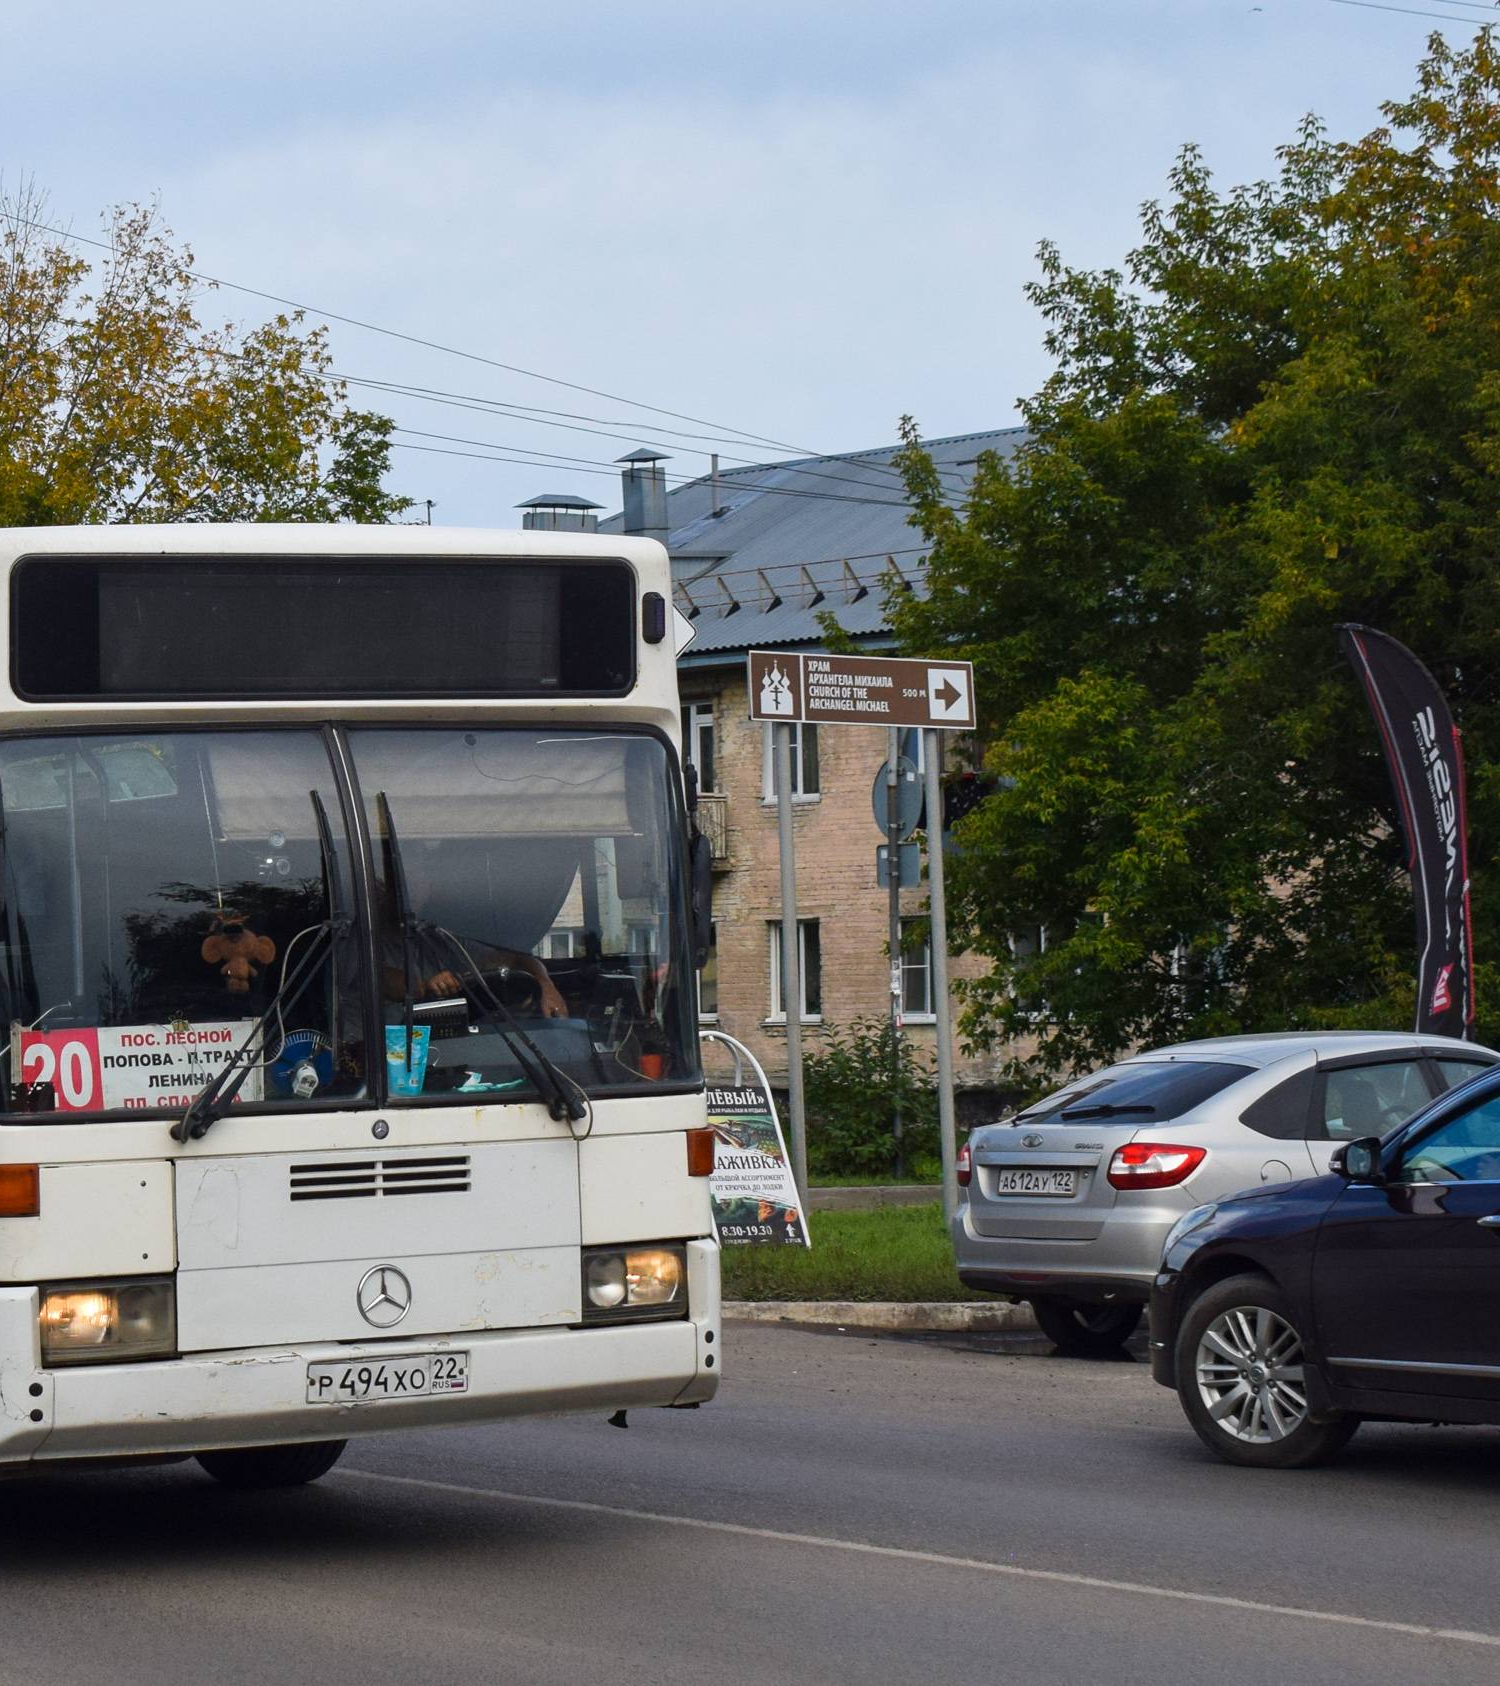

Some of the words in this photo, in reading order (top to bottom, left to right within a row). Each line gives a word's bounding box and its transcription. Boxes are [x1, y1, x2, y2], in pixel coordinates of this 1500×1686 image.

[808, 661, 831, 672] ХРАМ
[808, 673, 854, 687] АРХАНГЕЛА
[854, 675, 894, 688] МИХАИЛА
[808, 686, 841, 698] CHURCH
[841, 688, 852, 699] OF
[853, 688, 868, 699] THE
[902, 688, 918, 698] 500
[809, 698, 855, 711] ARCHANGEL
[855, 701, 890, 713] MICHAEL
[120, 1034, 161, 1047] ПОС.
[165, 1028, 232, 1046] ЛЕСНОЙ
[103, 1052, 174, 1069] ПОПОВА
[23, 1041, 94, 1109] 20
[148, 1072, 214, 1088] ЛЕНИНА
[707, 1088, 765, 1105] ЛЁВЫЙ»
[714, 1155, 782, 1170] АЖИВКА
[752, 1184, 761, 1192] ДО
[1002, 1172, 1049, 1190] А612АУ
[1052, 1172, 1071, 1187] 122
[721, 1225, 773, 1237] 8.30-19.30
[319, 1366, 425, 1396] Р494ХО
[434, 1358, 457, 1380] 22
[432, 1382, 450, 1390] RUS
